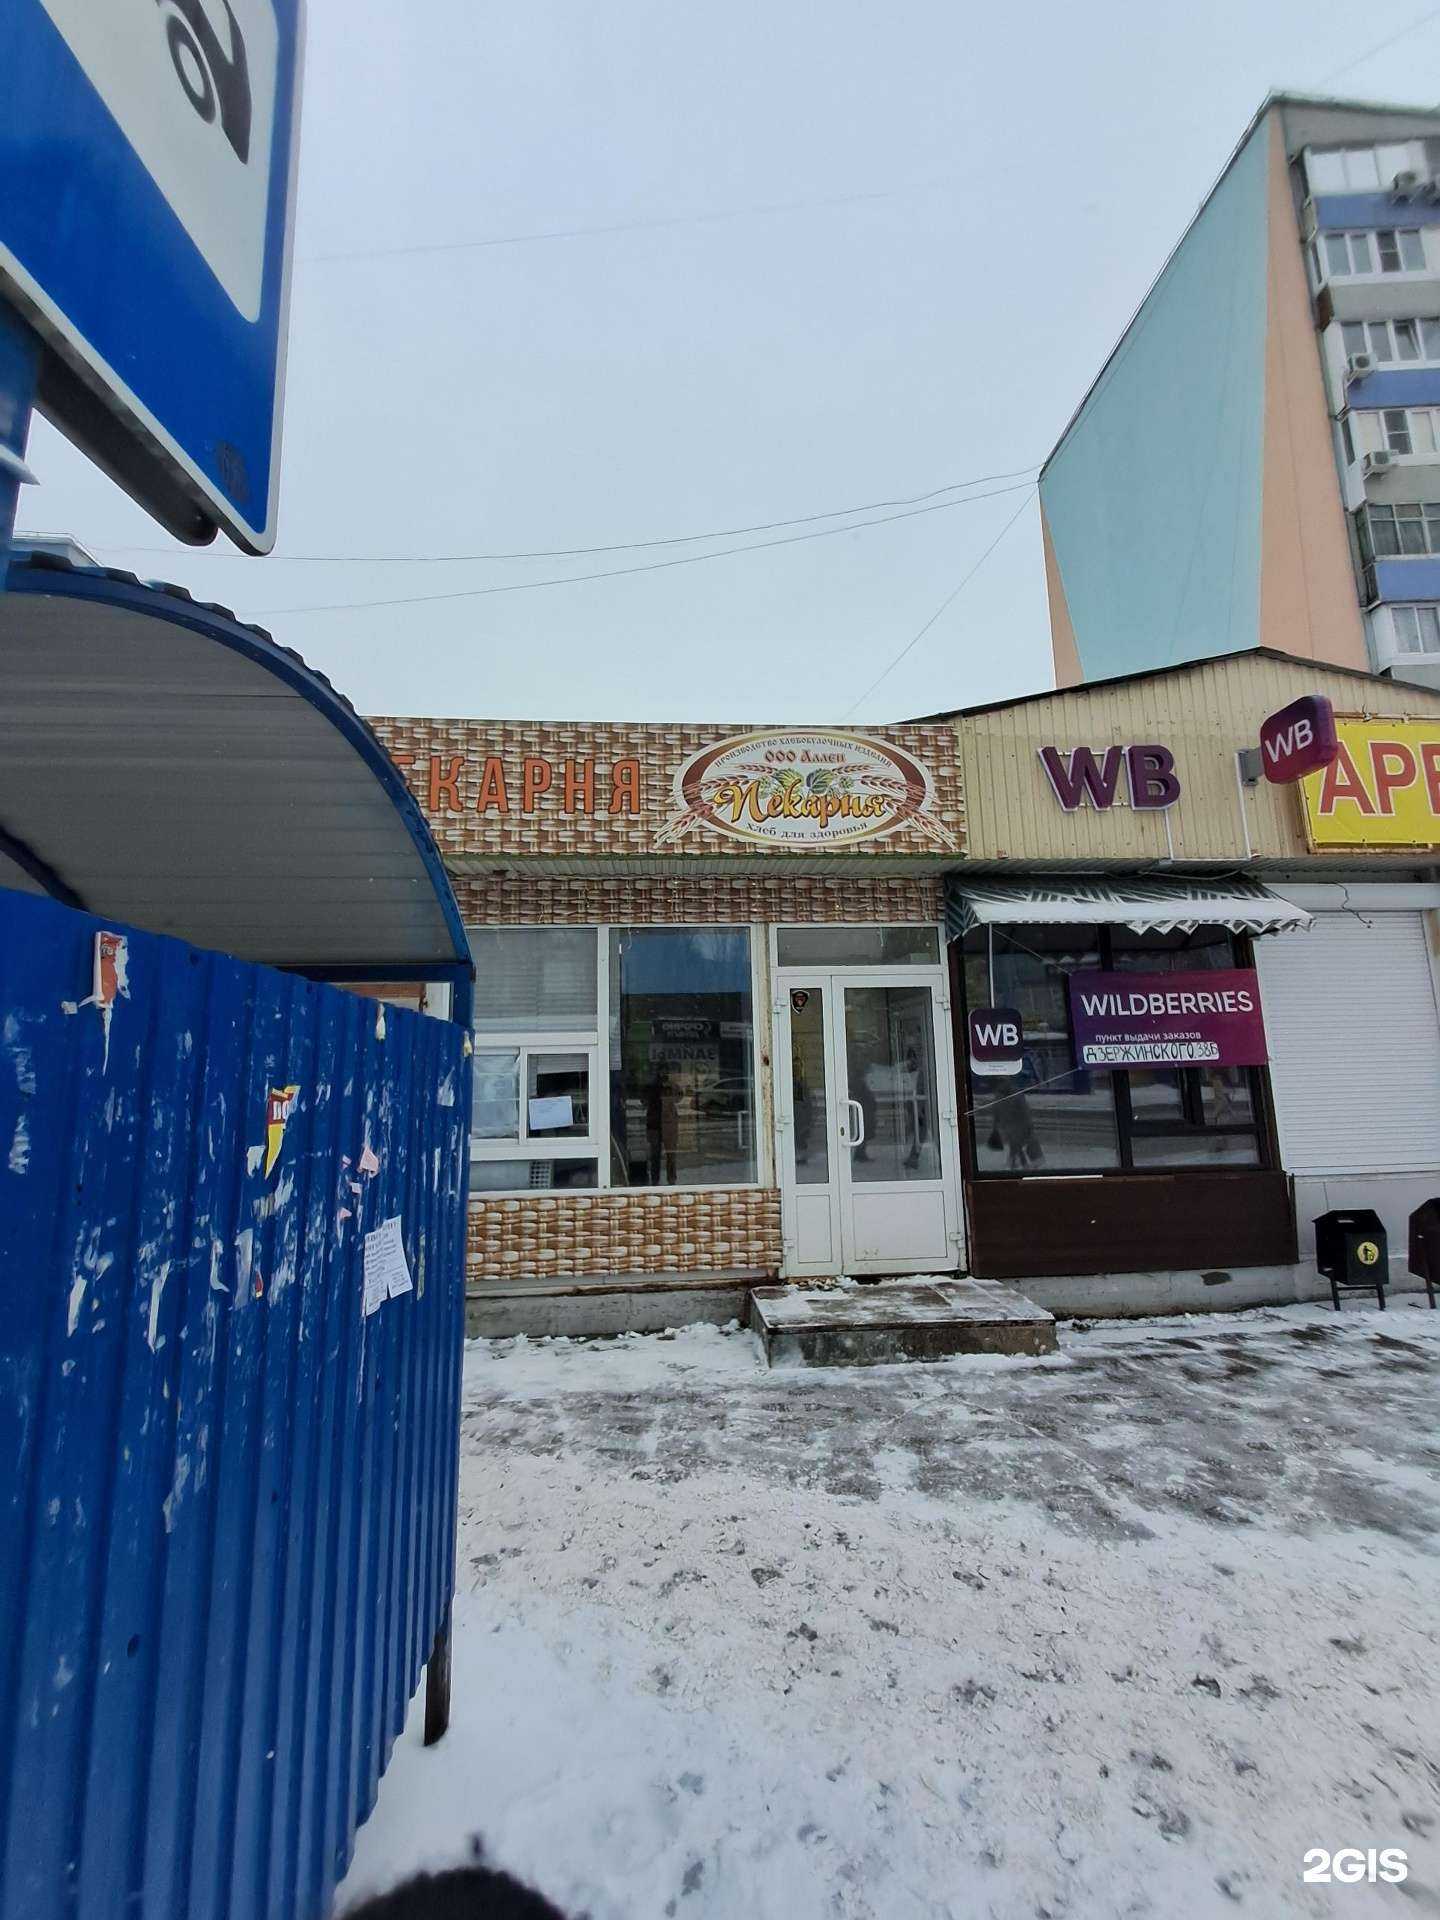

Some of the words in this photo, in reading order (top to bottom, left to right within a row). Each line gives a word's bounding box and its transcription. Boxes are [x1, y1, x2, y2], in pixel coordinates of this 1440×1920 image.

[1264, 718, 1314, 764] WB
[764, 750, 796, 763] ООО
[1037, 744, 1181, 812] WB
[713, 778, 886, 829] Пекарня
[780, 830, 805, 839] для
[809, 821, 868, 839] здоровья
[1080, 990, 1254, 1016] WILDBERRIES
[974, 1023, 1019, 1046] WB
[1095, 1033, 1123, 1044] пункт
[1124, 1032, 1161, 1042] выдачи
[1163, 1031, 1202, 1041] заказов
